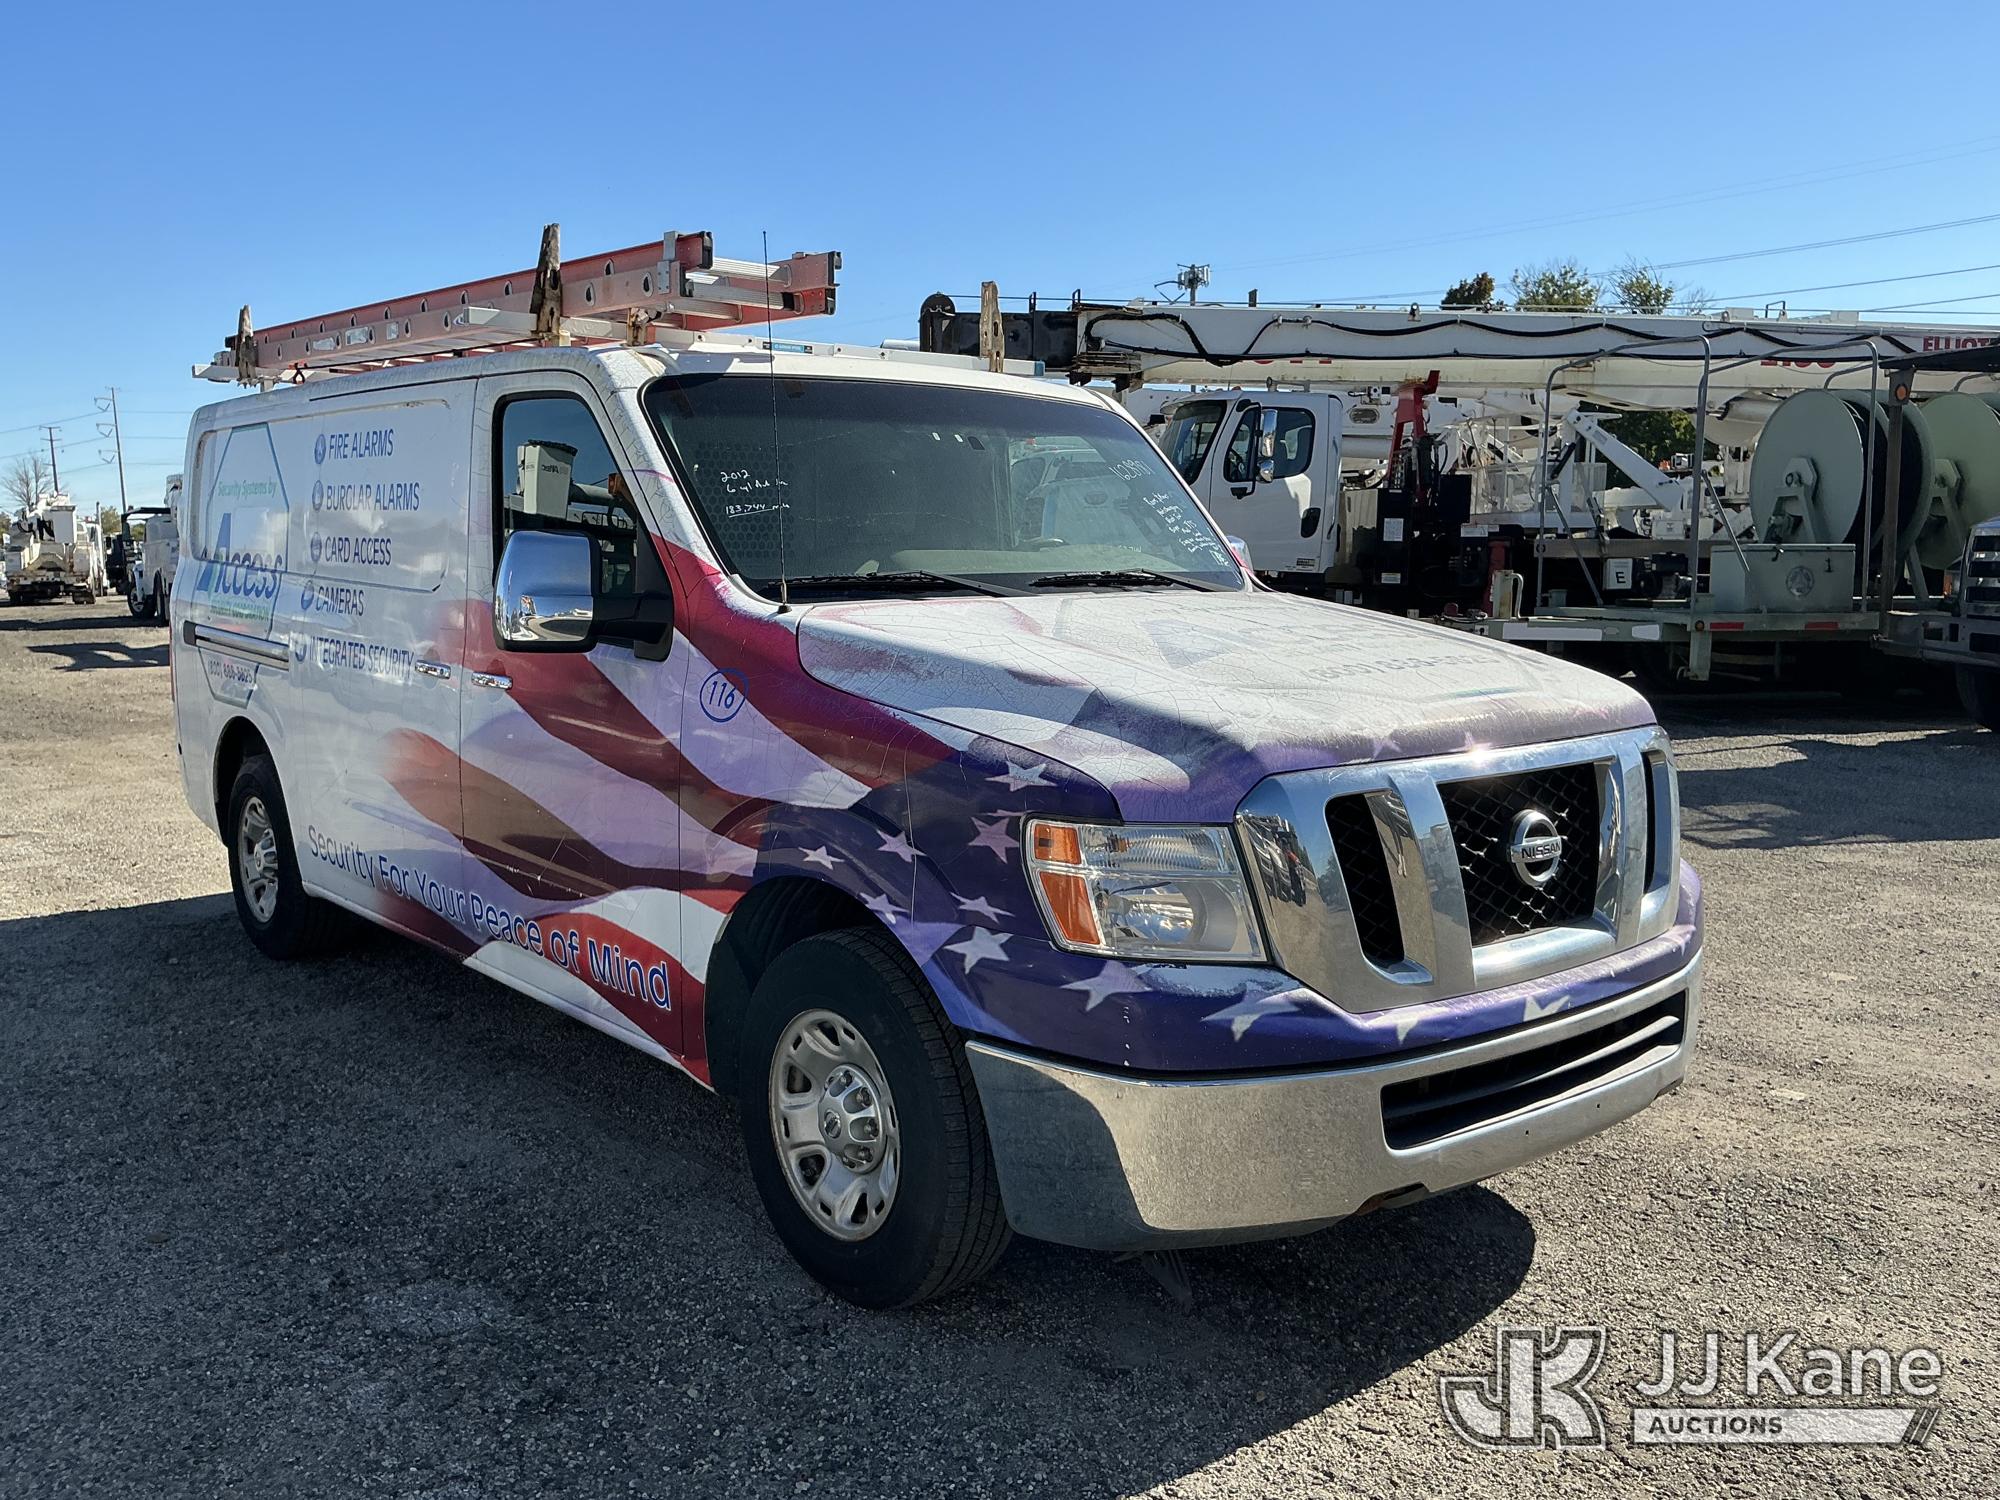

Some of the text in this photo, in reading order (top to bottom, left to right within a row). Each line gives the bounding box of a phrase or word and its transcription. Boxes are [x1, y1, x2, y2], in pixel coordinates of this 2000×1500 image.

[328, 429, 394, 460] FIRE ALARMS
[720, 469, 751, 483] 2012
[326, 482, 420, 511] BURGLAR ALARMS
[197, 512, 283, 599] Access
[325, 536, 391, 566] CARD ACCESS
[1615, 571, 1626, 584] E
[315, 585, 365, 616] CAMERAS
[309, 636, 414, 679] INTEGRATED SECURITY
[708, 681, 736, 709] 116
[1521, 842, 1560, 858] NISSAN
[308, 825, 671, 1011] Security For Your Peace of Mind
